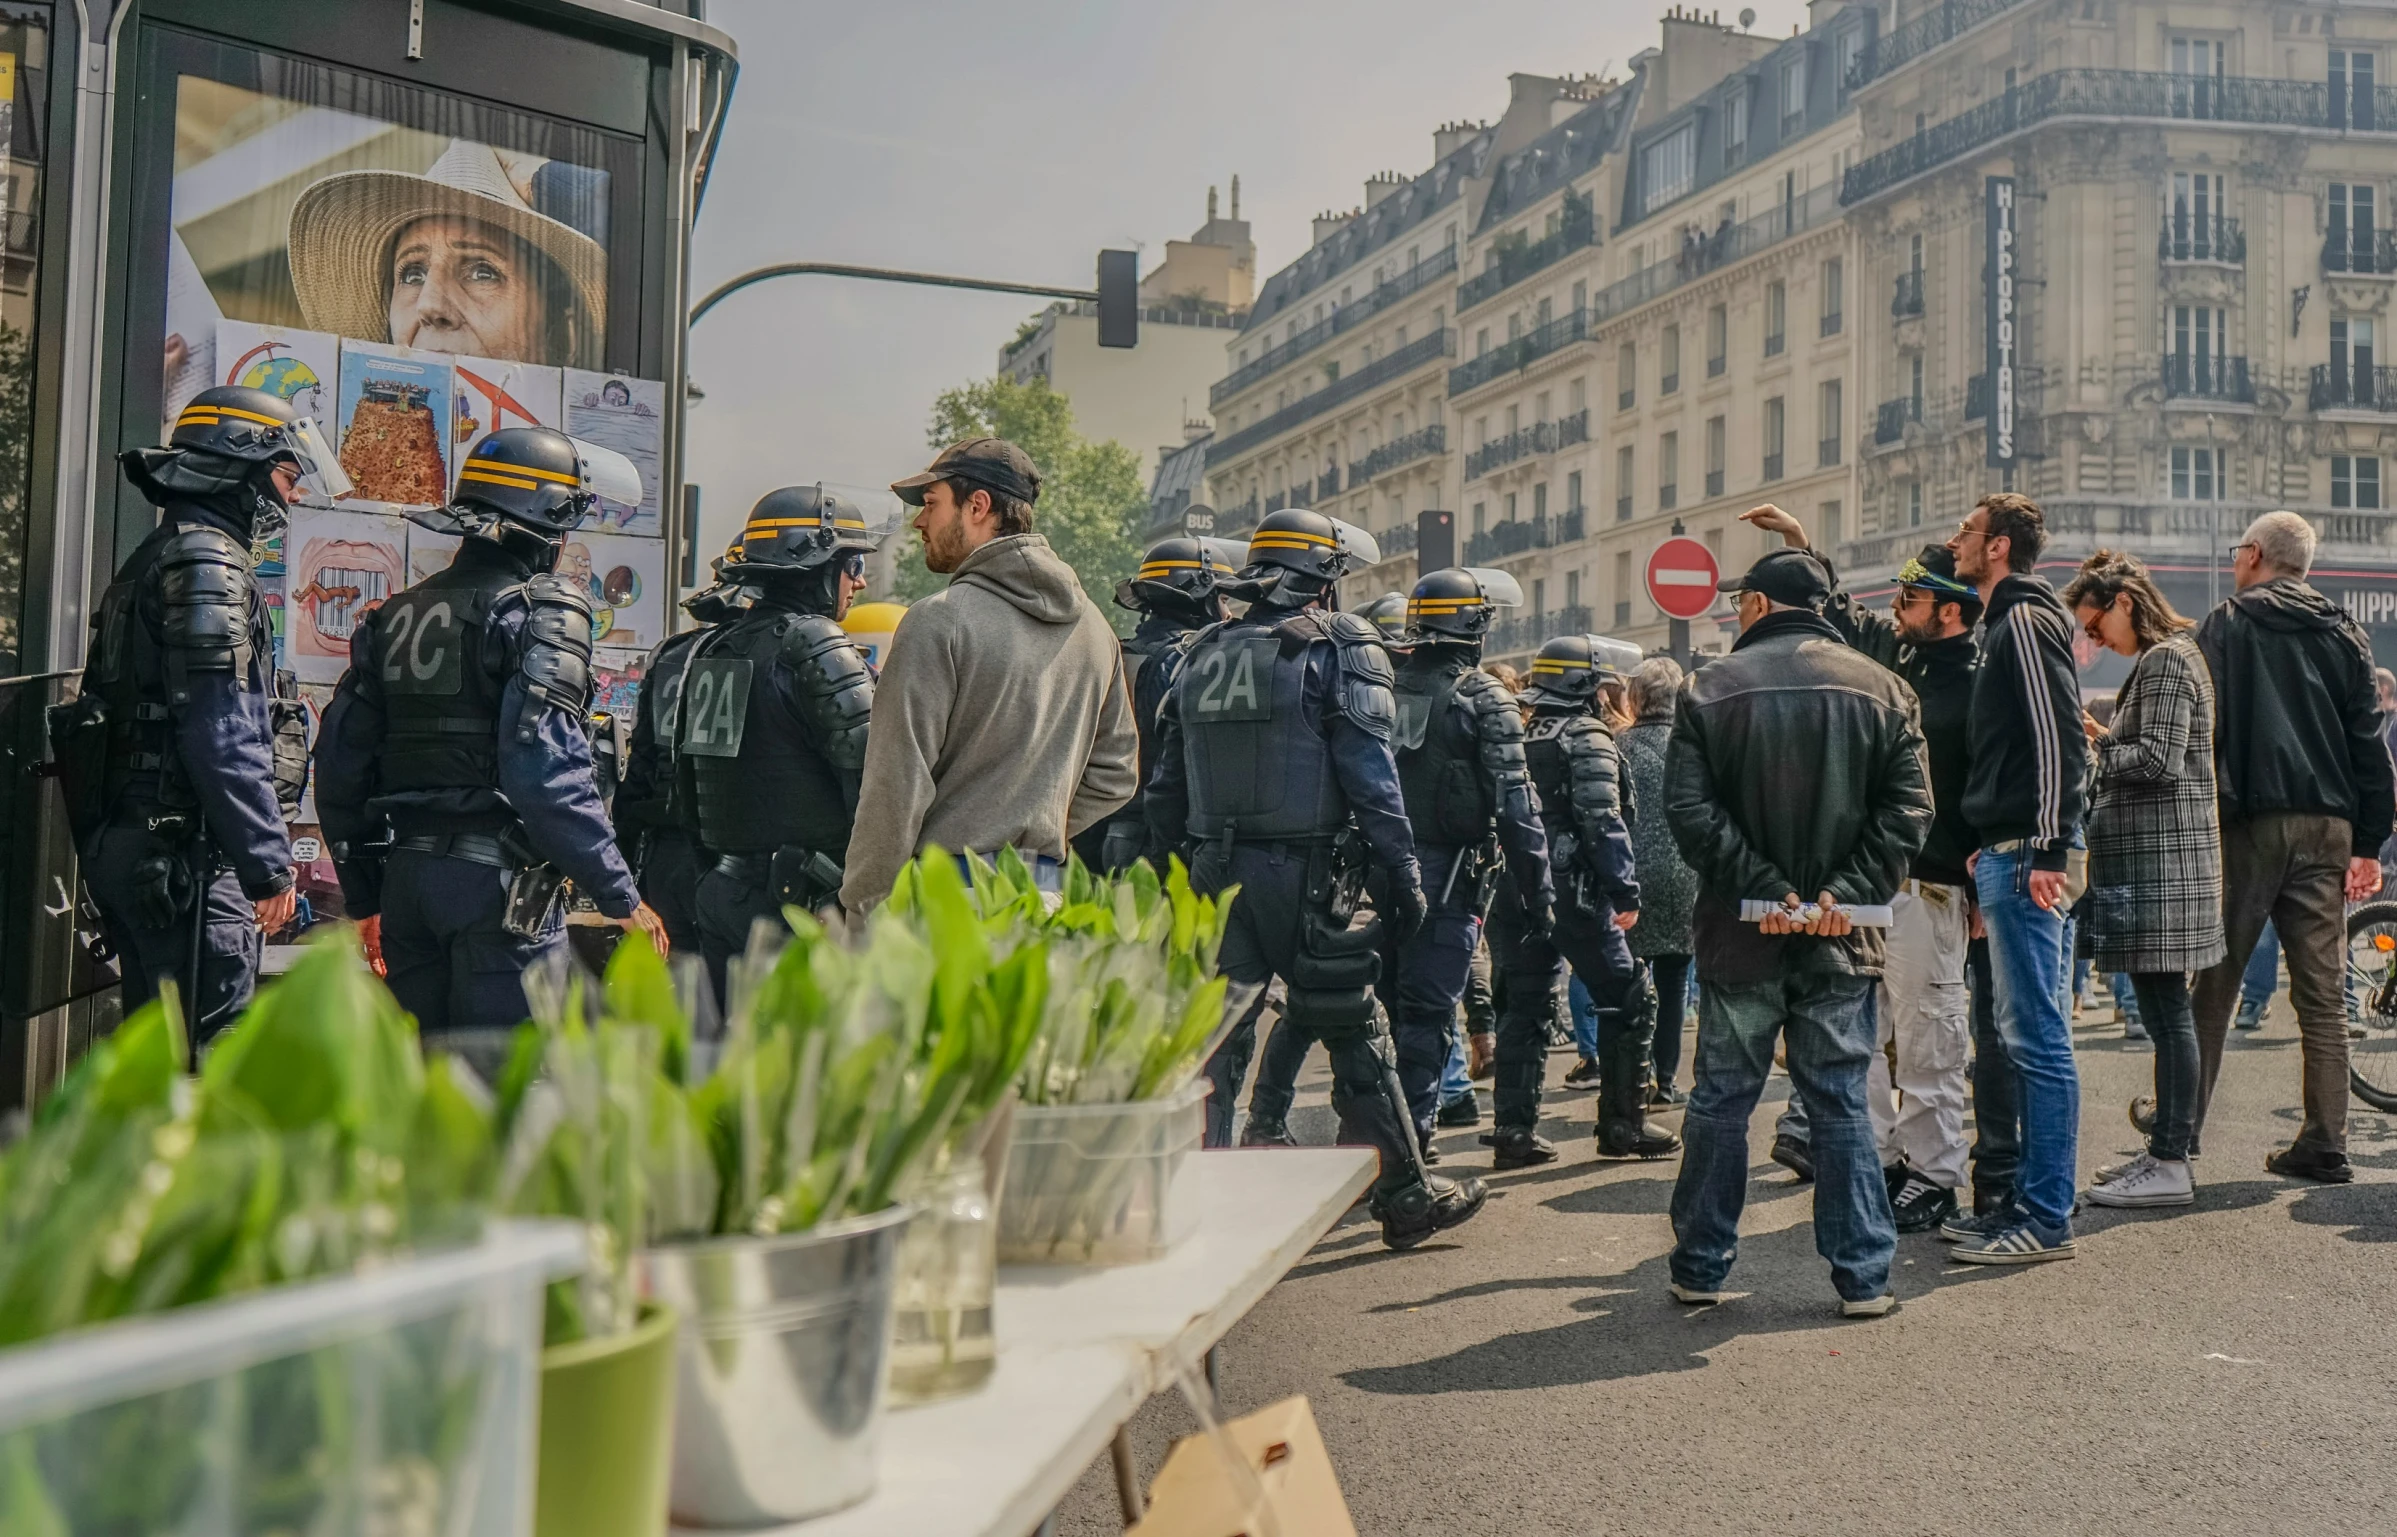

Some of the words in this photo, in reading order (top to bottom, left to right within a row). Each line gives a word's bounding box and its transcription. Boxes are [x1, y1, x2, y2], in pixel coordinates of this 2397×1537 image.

[1997, 183, 2013, 458] HIPPOPOTAMUS
[1187, 513, 1214, 530] BUS
[383, 601, 452, 681] 2C
[2343, 590, 2397, 623] HIPP
[691, 670, 735, 745] 2A
[1198, 648, 1258, 712] 2A
